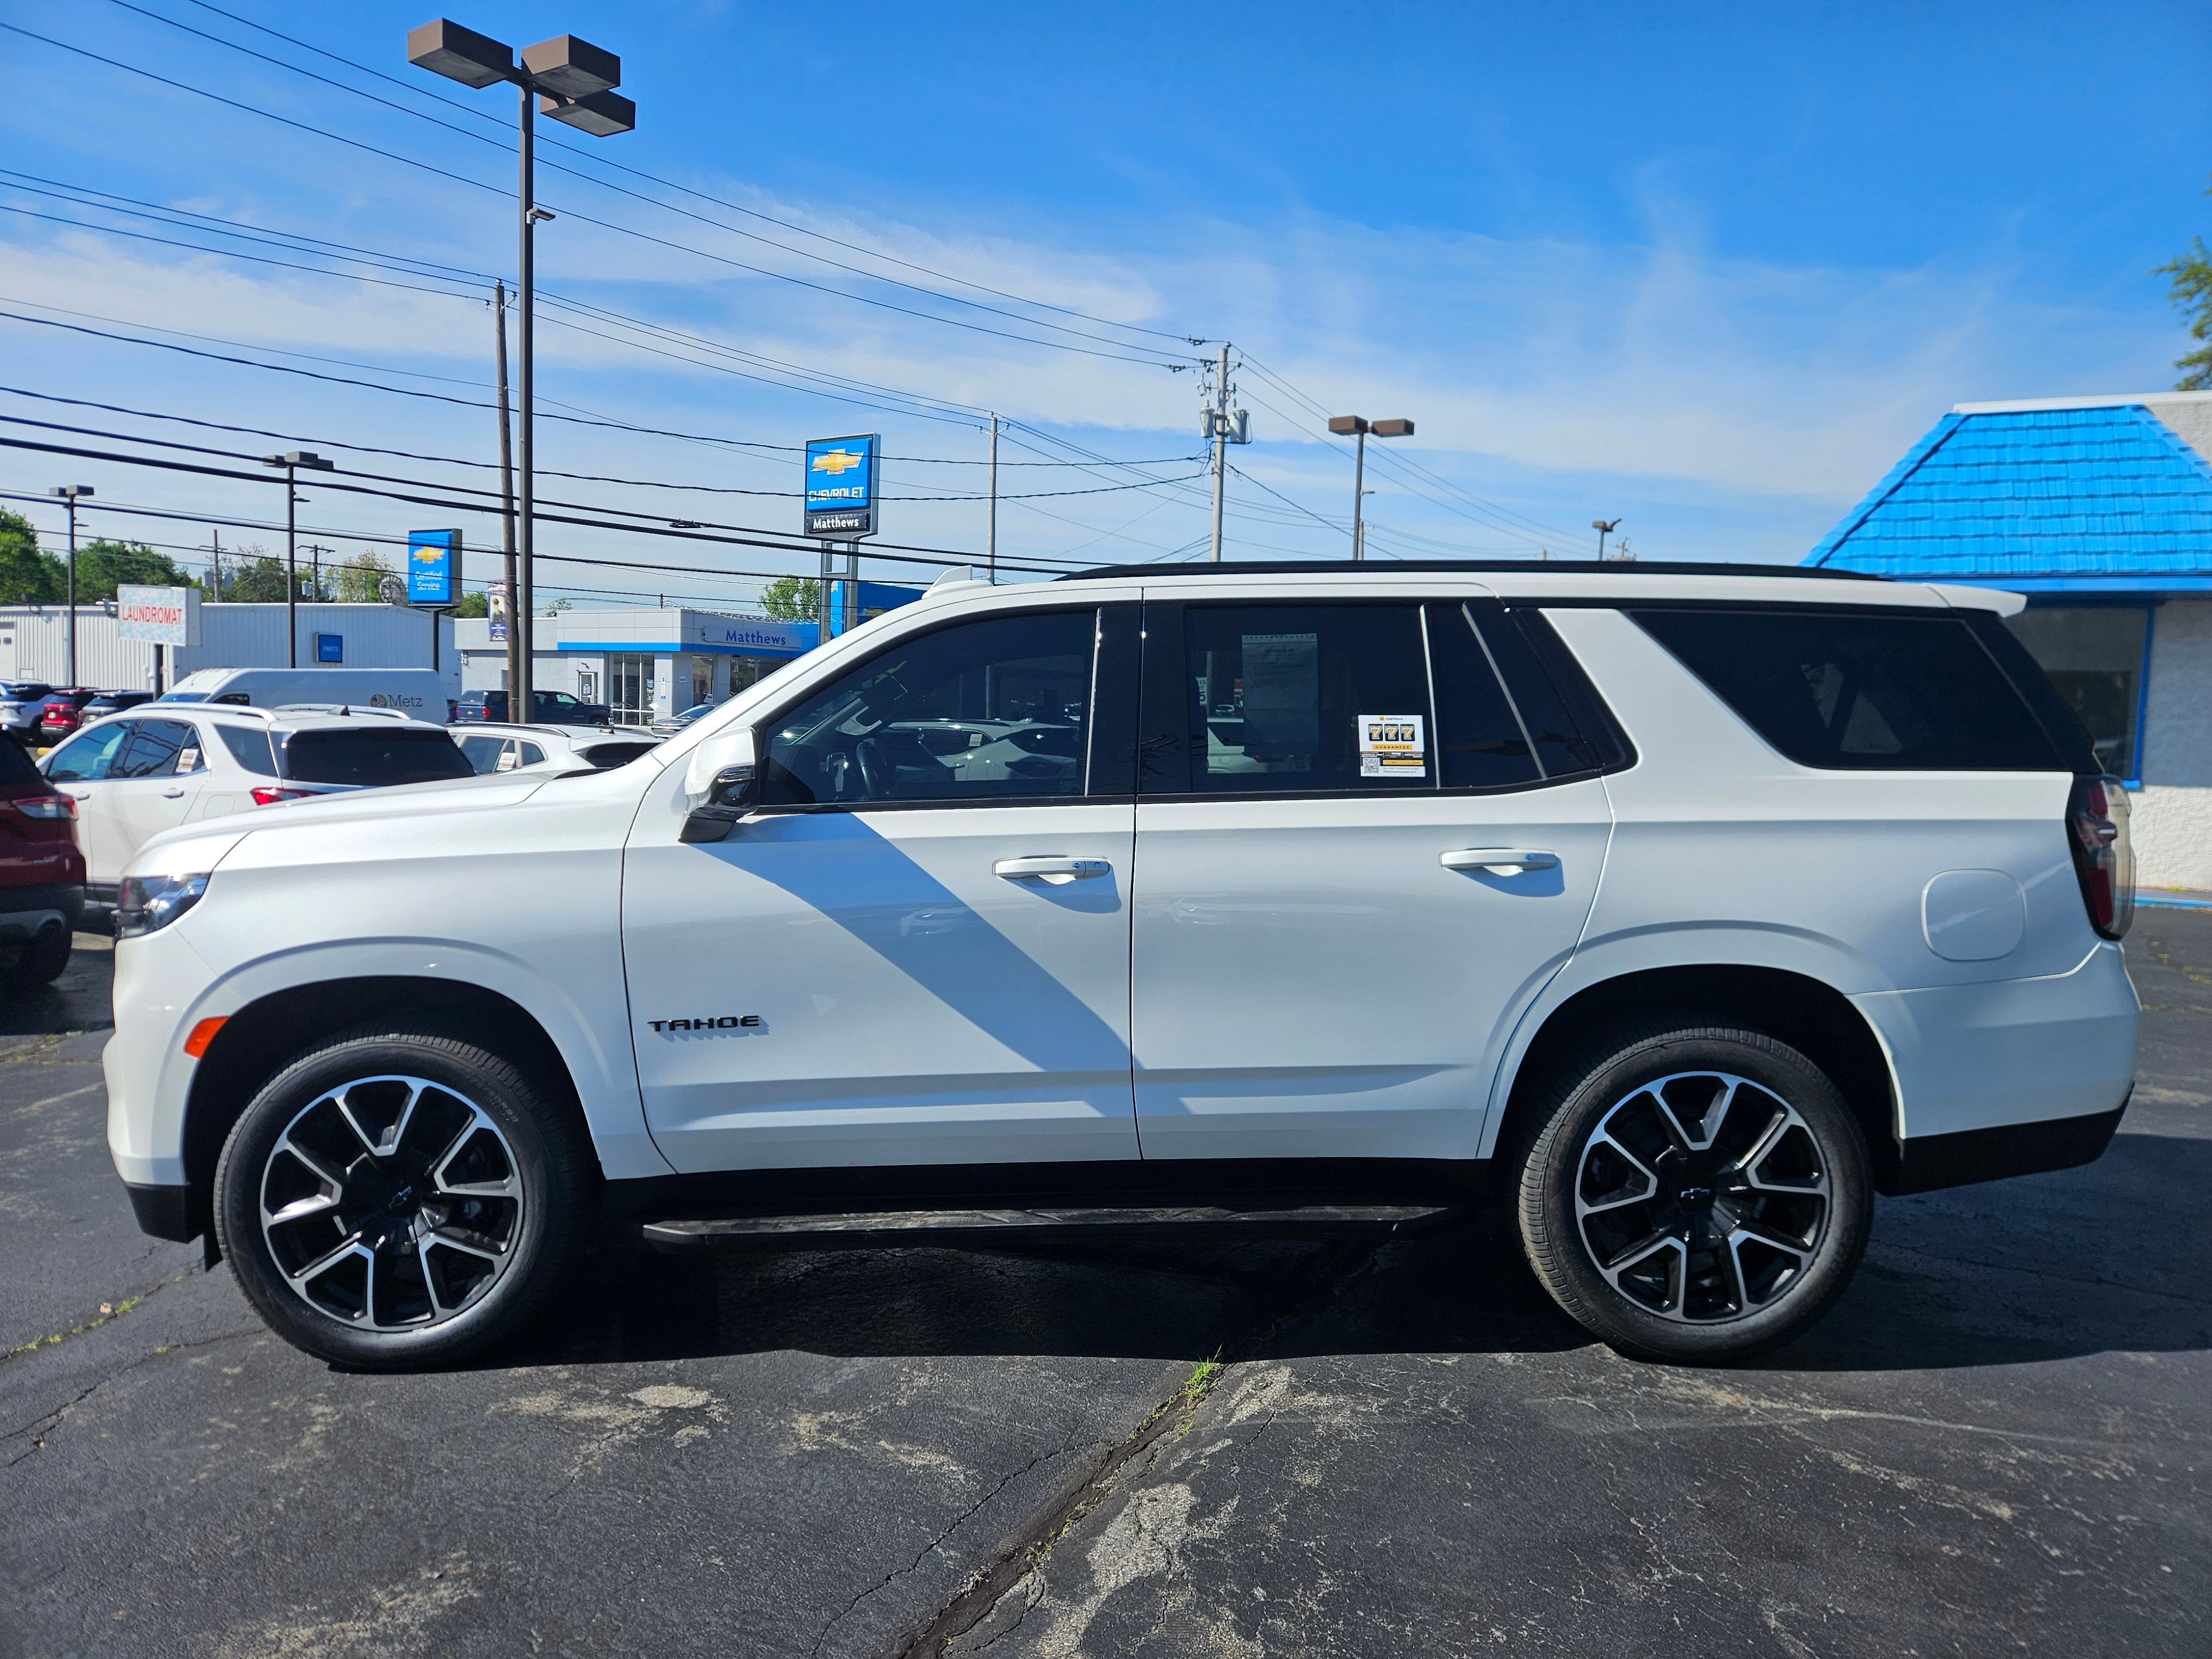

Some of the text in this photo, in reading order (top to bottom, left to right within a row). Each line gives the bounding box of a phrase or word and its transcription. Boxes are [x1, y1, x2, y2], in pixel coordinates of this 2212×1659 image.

[808, 486, 864, 502] CHEVROLET
[813, 516, 859, 529] Matthews
[415, 571, 442, 581] Certified
[416, 581, 440, 591] Service
[122, 604, 182, 625] LAUNDROMAT
[726, 629, 786, 645] Matthews
[388, 695, 423, 707] Metz
[1199, 691, 1206, 701] 5
[646, 1015, 759, 1032] TAHOE
